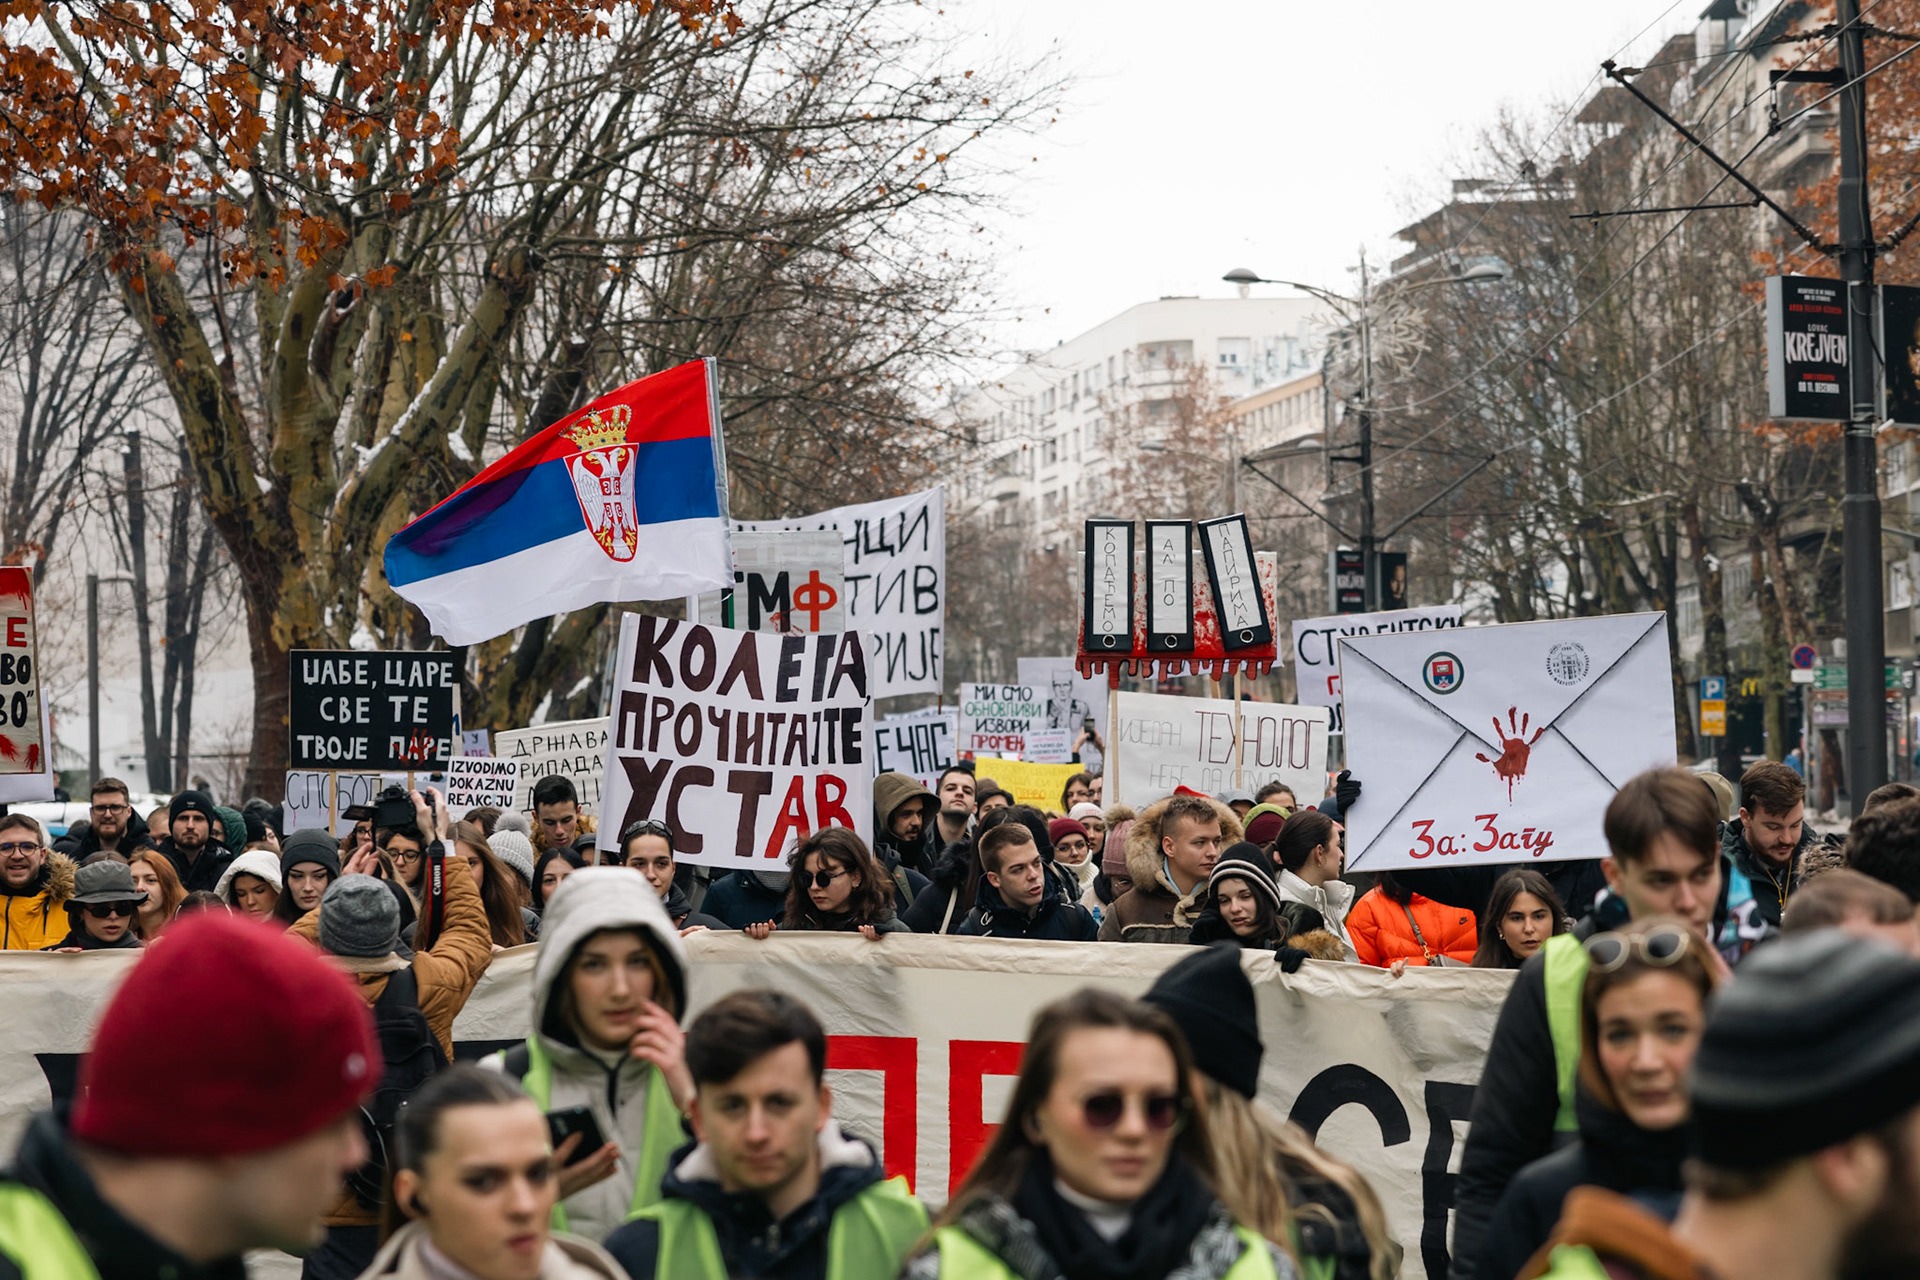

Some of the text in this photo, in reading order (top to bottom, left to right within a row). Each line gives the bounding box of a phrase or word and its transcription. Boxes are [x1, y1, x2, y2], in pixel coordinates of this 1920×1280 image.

[1784, 331, 1848, 368] KREJVEN
[1102, 526, 1117, 633] КОПАЋЕМО
[1218, 523, 1249, 628] ПАПИРИМА
[384, 659, 454, 688] ЦАРЕ
[631, 614, 872, 707] КОЛЕГА,
[974, 685, 1033, 702] МИ СМО
[319, 695, 429, 724] СВЕ ТЕ
[615, 689, 863, 767] ПРОЧИТАЈТЕ
[976, 718, 1030, 734] ИЗВОРИ
[1194, 710, 1325, 770] ТЕХНОЛОГ
[296, 734, 452, 762] ТВОЈЕ ПАРЕ
[511, 729, 609, 758] ДРЖАВА
[451, 760, 517, 775] IZVODIMO
[449, 776, 515, 791] DOKAZNU
[616, 756, 856, 859] УСТАВ
[432, 864, 442, 896] Canon
